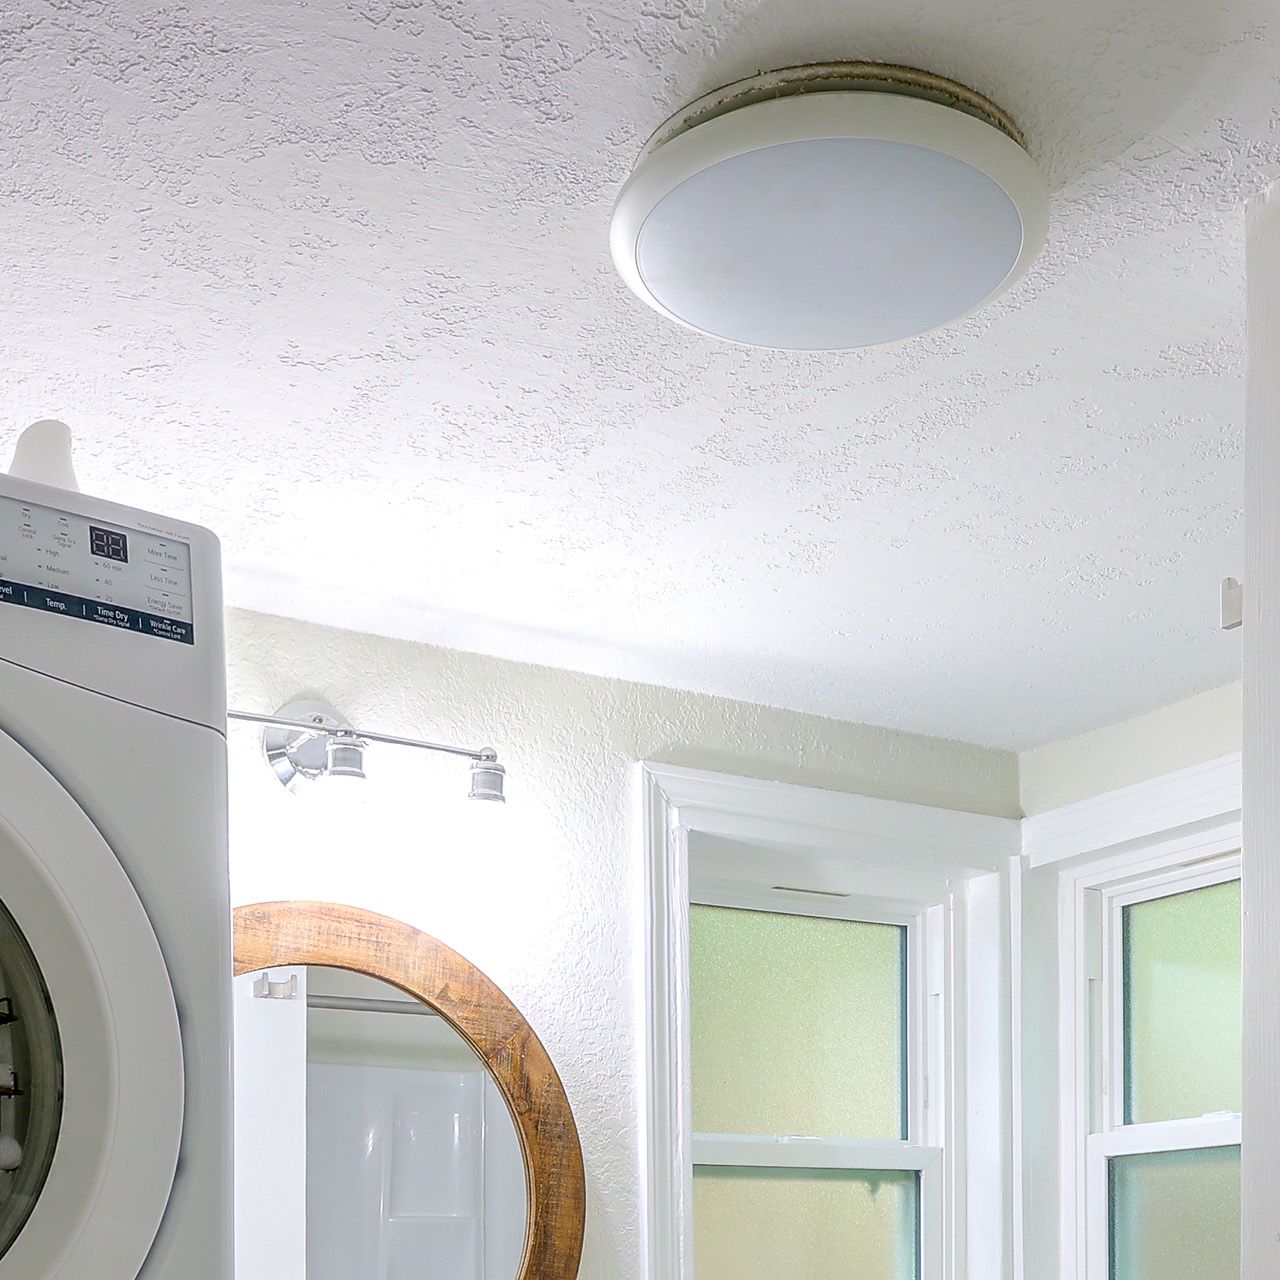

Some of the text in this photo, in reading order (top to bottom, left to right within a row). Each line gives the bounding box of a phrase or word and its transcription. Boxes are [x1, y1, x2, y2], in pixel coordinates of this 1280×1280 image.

[46, 548, 60, 558] High
[148, 548, 178, 561] More Time
[46, 565, 70, 575] Medium
[150, 574, 178, 586] Less Time
[45, 598, 66, 610] Temp.
[148, 596, 183, 610] Energy Saver
[97, 606, 128, 622] Time Dry
[150, 620, 186, 634] Wrinkle Care
